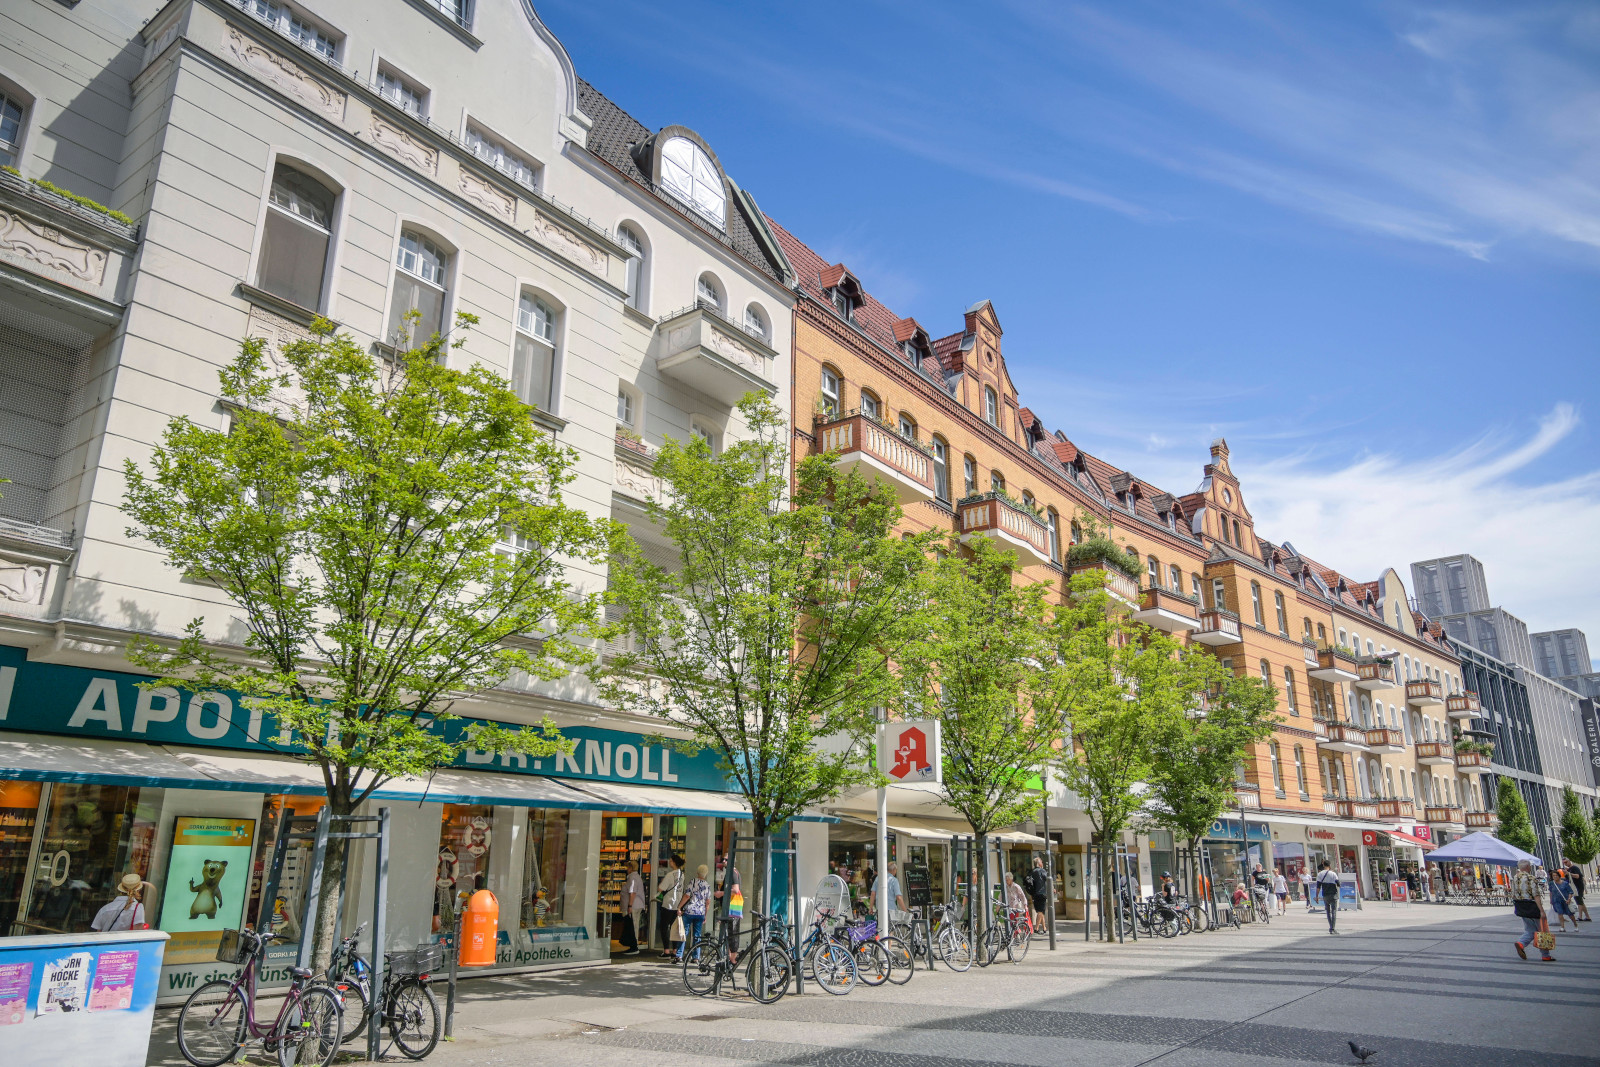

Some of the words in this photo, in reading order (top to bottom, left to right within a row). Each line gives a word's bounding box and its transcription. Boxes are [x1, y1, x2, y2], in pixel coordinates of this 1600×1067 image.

[1586, 717, 1600, 754] GALERIA
[555, 737, 678, 783] KNOLL
[494, 950, 512, 964] rki
[514, 946, 574, 965] Apotheke.
[168, 971, 198, 990] Wir
